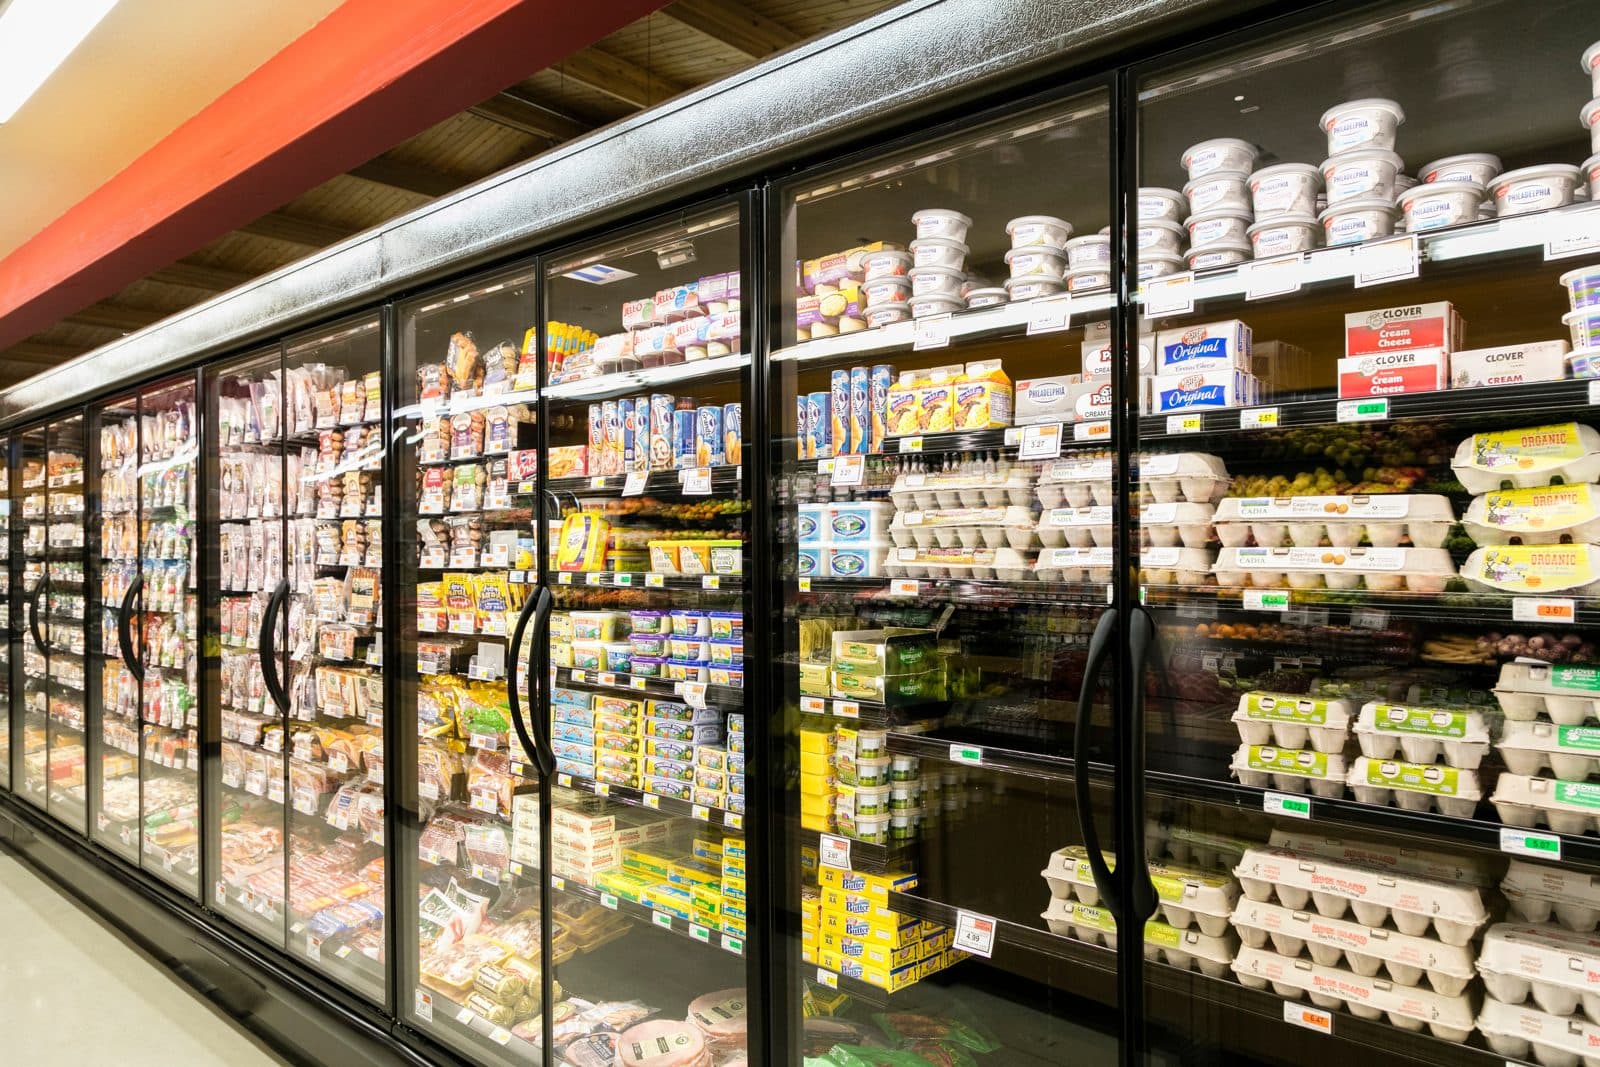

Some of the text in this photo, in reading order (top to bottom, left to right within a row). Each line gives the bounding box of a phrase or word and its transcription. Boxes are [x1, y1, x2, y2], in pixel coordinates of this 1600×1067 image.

[1333, 120, 1369, 134] PHILADELPHIA
[1333, 170, 1369, 183] PHILADELPHIA
[1507, 187, 1551, 201] PHILADELPHIA
[1412, 203, 1450, 217] PHILADELPHIA
[1331, 220, 1367, 233] PHILADELPHIA
[1382, 306, 1422, 318] CLOVER
[1379, 328, 1410, 338] Cream
[1378, 337, 1412, 347] Cheese
[1172, 339, 1220, 360] Original
[1375, 353, 1415, 365] CLOVER
[1485, 351, 1524, 363] CLOVER
[1372, 375, 1403, 384] Cream
[1487, 375, 1523, 385] CREAM
[1028, 386, 1066, 398] PHILADELPHIA
[1370, 384, 1405, 395] Cheese
[1168, 386, 1218, 407] Original
[1258, 414, 1273, 422] 2.57
[1521, 433, 1567, 448] ORGANIC
[1533, 493, 1578, 507] ORGANIC
[1531, 554, 1576, 566] ORGANIC
[1545, 606, 1564, 615] 3.67
[842, 879, 866, 891] Butter
[846, 901, 870, 913] Butter
[846, 923, 870, 935] Butter
[965, 932, 980, 942] 4.99
[841, 943, 864, 956] Butter
[841, 965, 864, 978] Butter
[1309, 1014, 1325, 1024] 6.47
